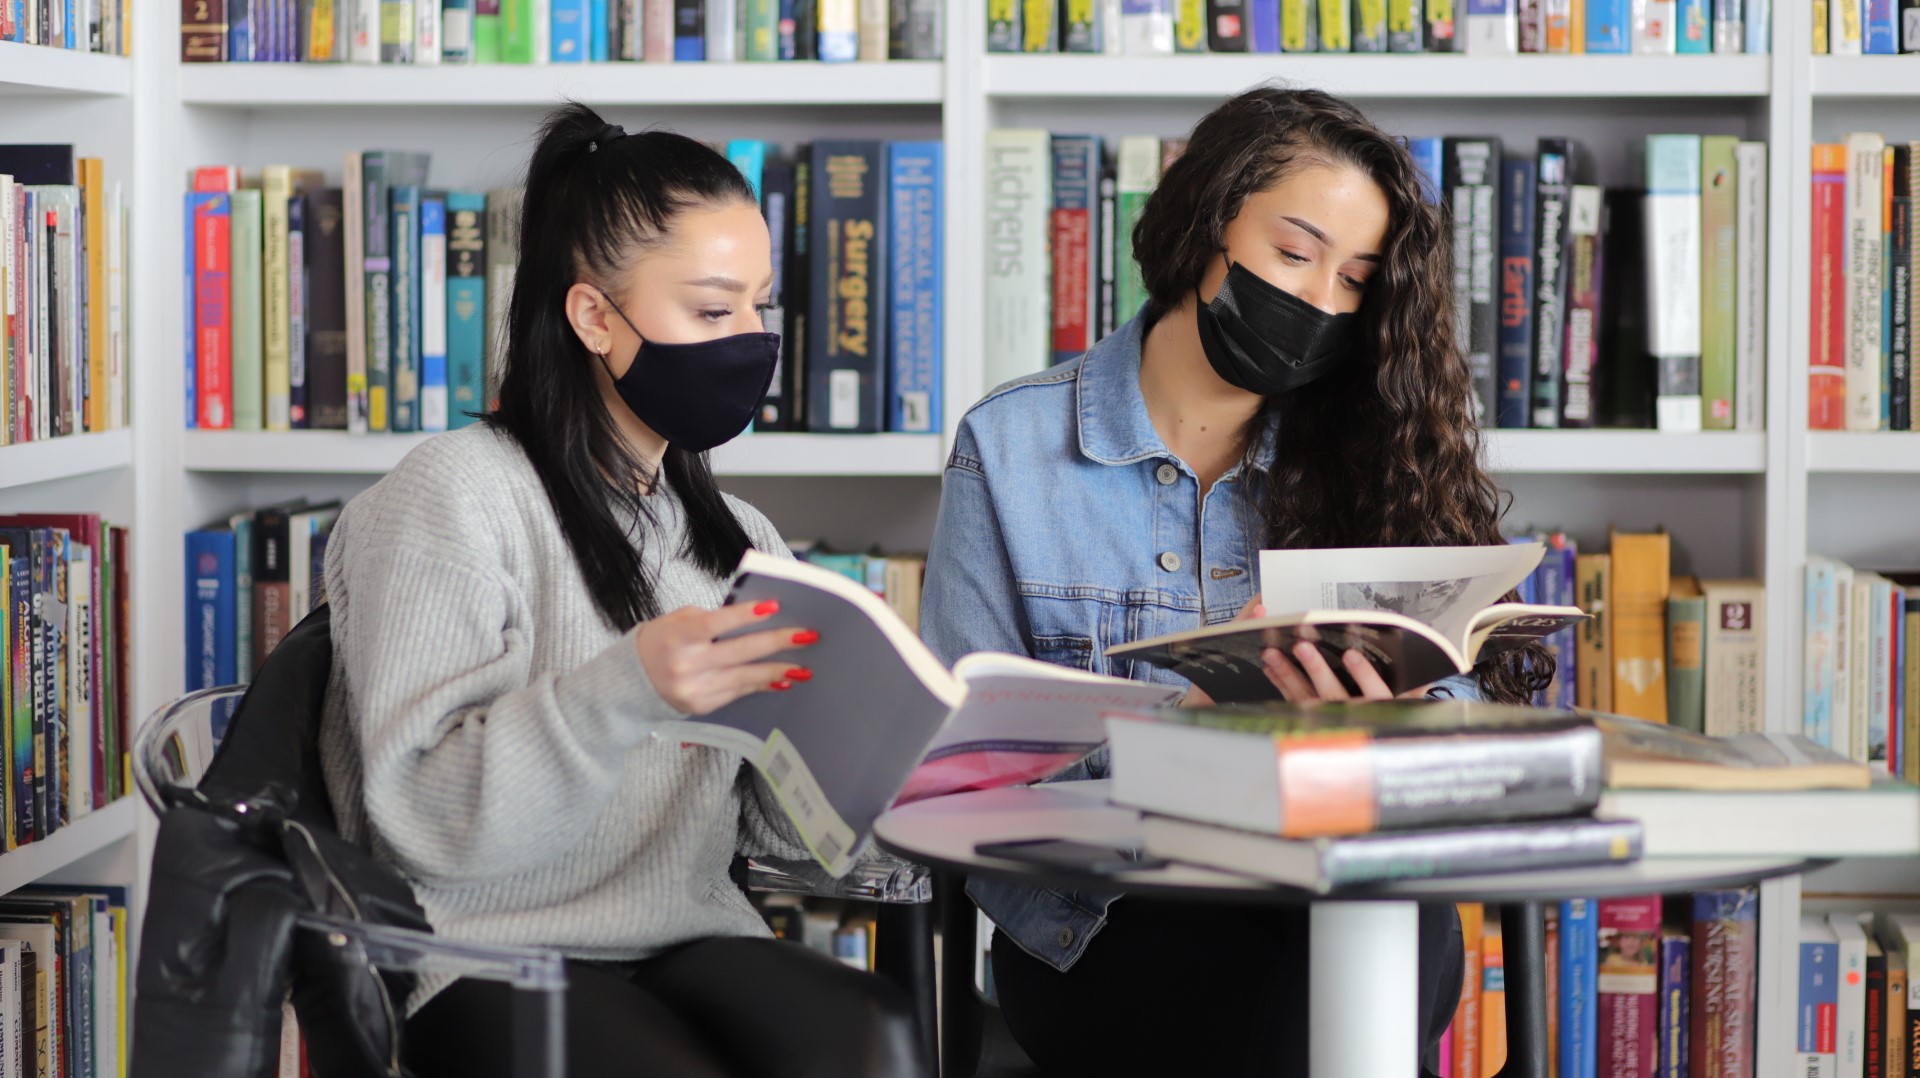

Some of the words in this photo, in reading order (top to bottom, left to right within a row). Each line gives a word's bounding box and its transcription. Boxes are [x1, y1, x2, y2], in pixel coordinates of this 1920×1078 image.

[917, 188, 933, 281] CLINICAL
[989, 146, 1033, 279] Lichens
[896, 189, 913, 306] RESONANCE
[1853, 218, 1866, 273] HUMAN
[839, 218, 874, 357] Surgery
[1503, 256, 1532, 327] Earth
[1867, 240, 1880, 324] PRINCIPLES
[1894, 265, 1907, 325] MAPPING
[1867, 326, 1880, 346] OF
[1894, 326, 1907, 351] THE
[33, 627, 44, 669] THE
[1725, 603, 1747, 629] 2
[34, 670, 45, 723] CELL
[1703, 921, 1725, 1013] NURSING
